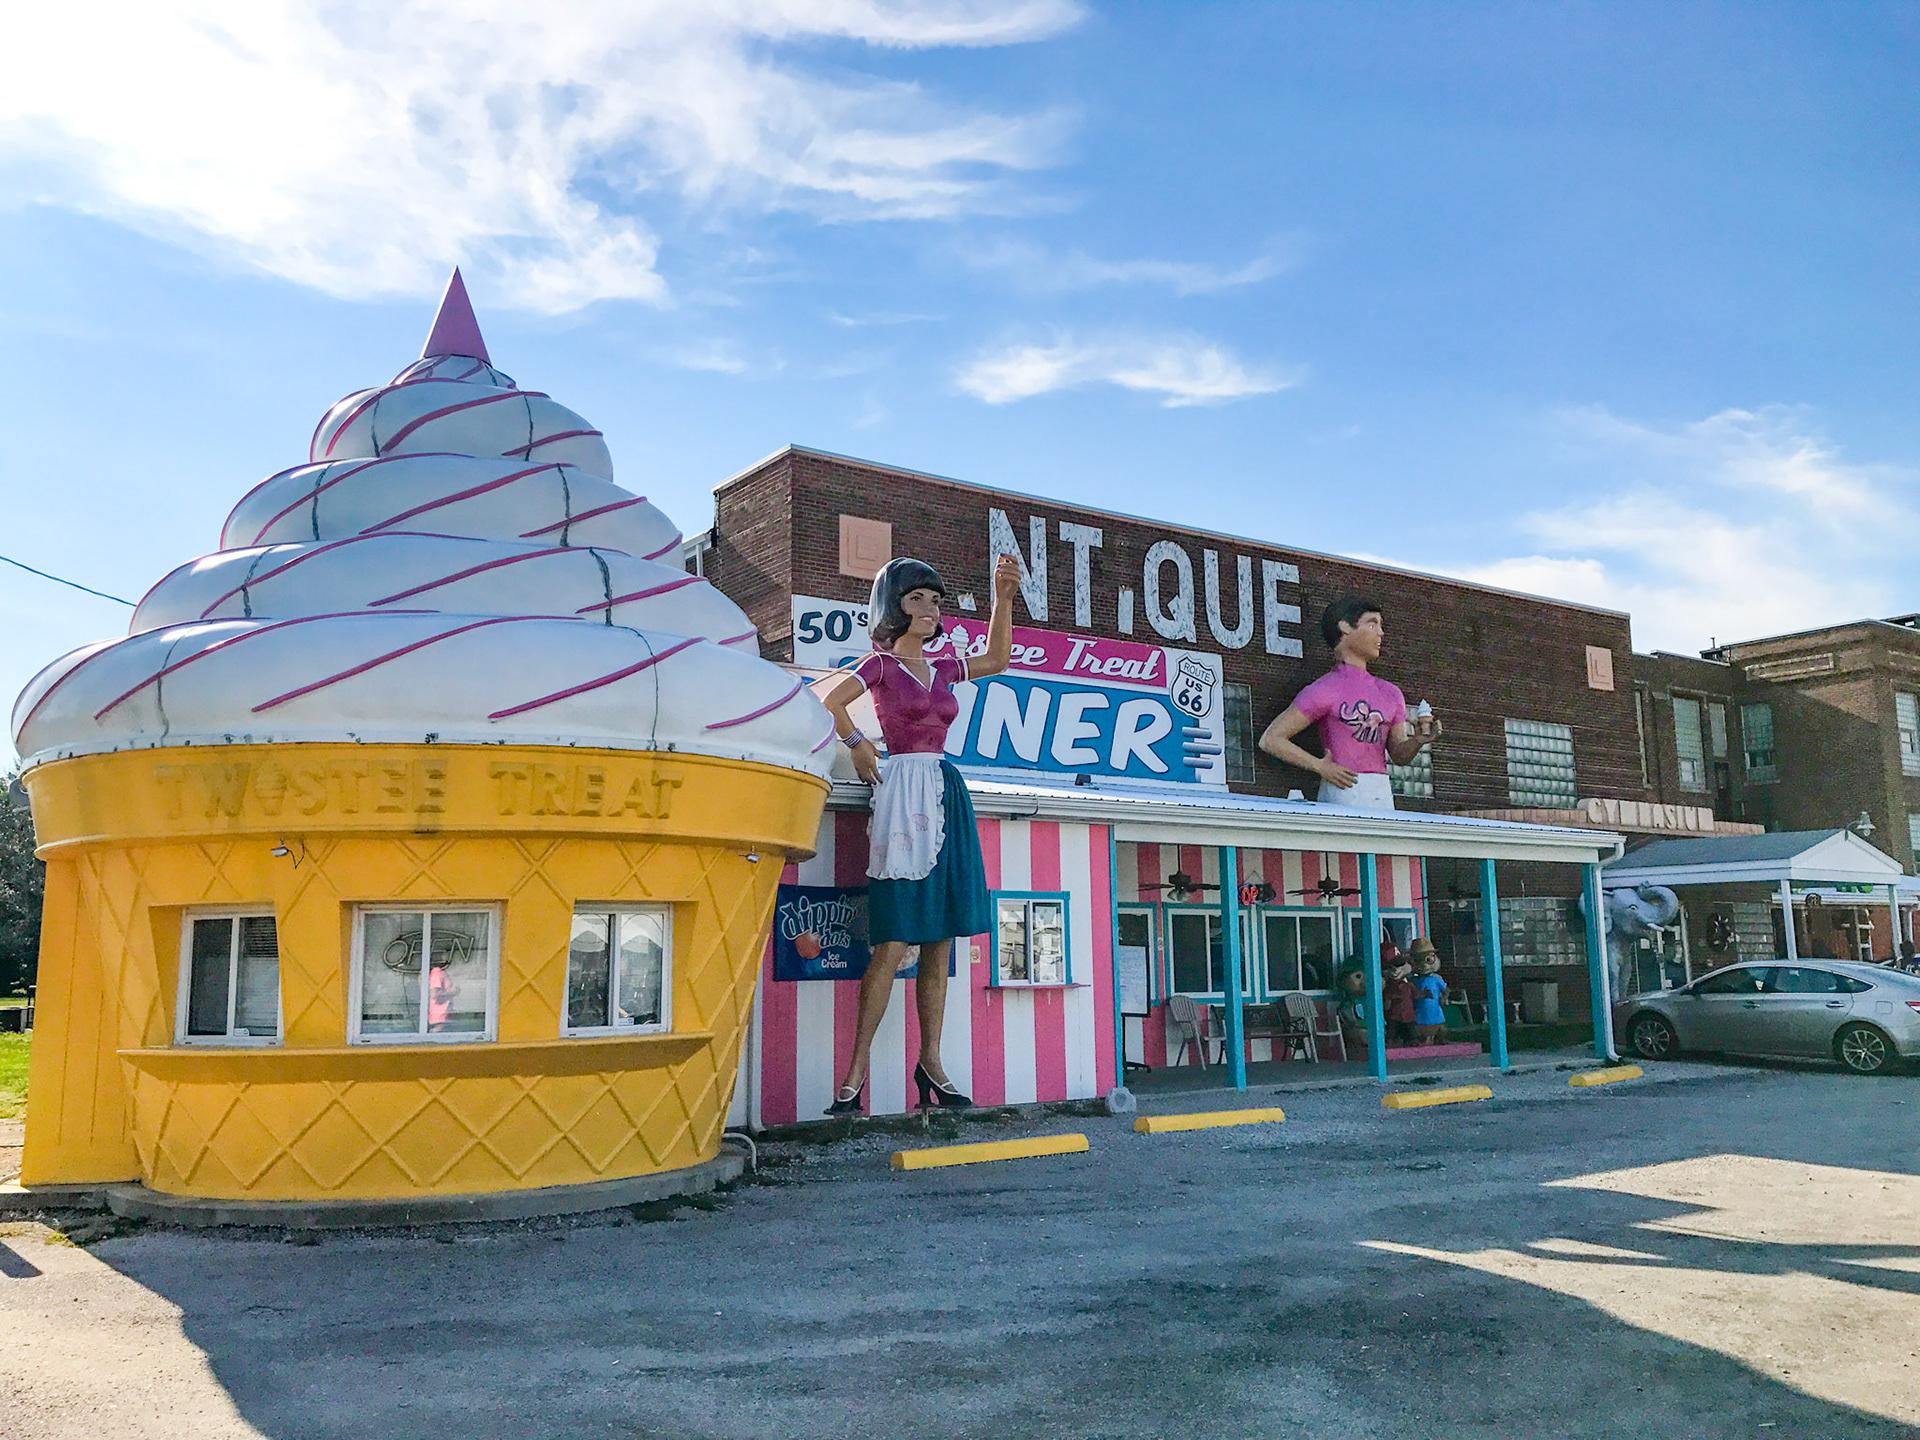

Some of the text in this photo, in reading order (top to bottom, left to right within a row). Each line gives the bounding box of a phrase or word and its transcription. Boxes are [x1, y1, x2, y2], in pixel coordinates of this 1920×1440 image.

[957, 507, 1303, 659] NTQUE
[798, 610, 868, 644] 50's
[1063, 638, 1160, 680] Treat
[1183, 662, 1211, 682] ROUTE
[1185, 678, 1203, 692] US
[1178, 688, 1202, 712] 66
[943, 680, 1173, 774] INER
[155, 759, 684, 820] TWSTEE TREAT
[818, 922, 851, 949] dots
[821, 959, 848, 969] Cream
[827, 950, 840, 961] Ice
